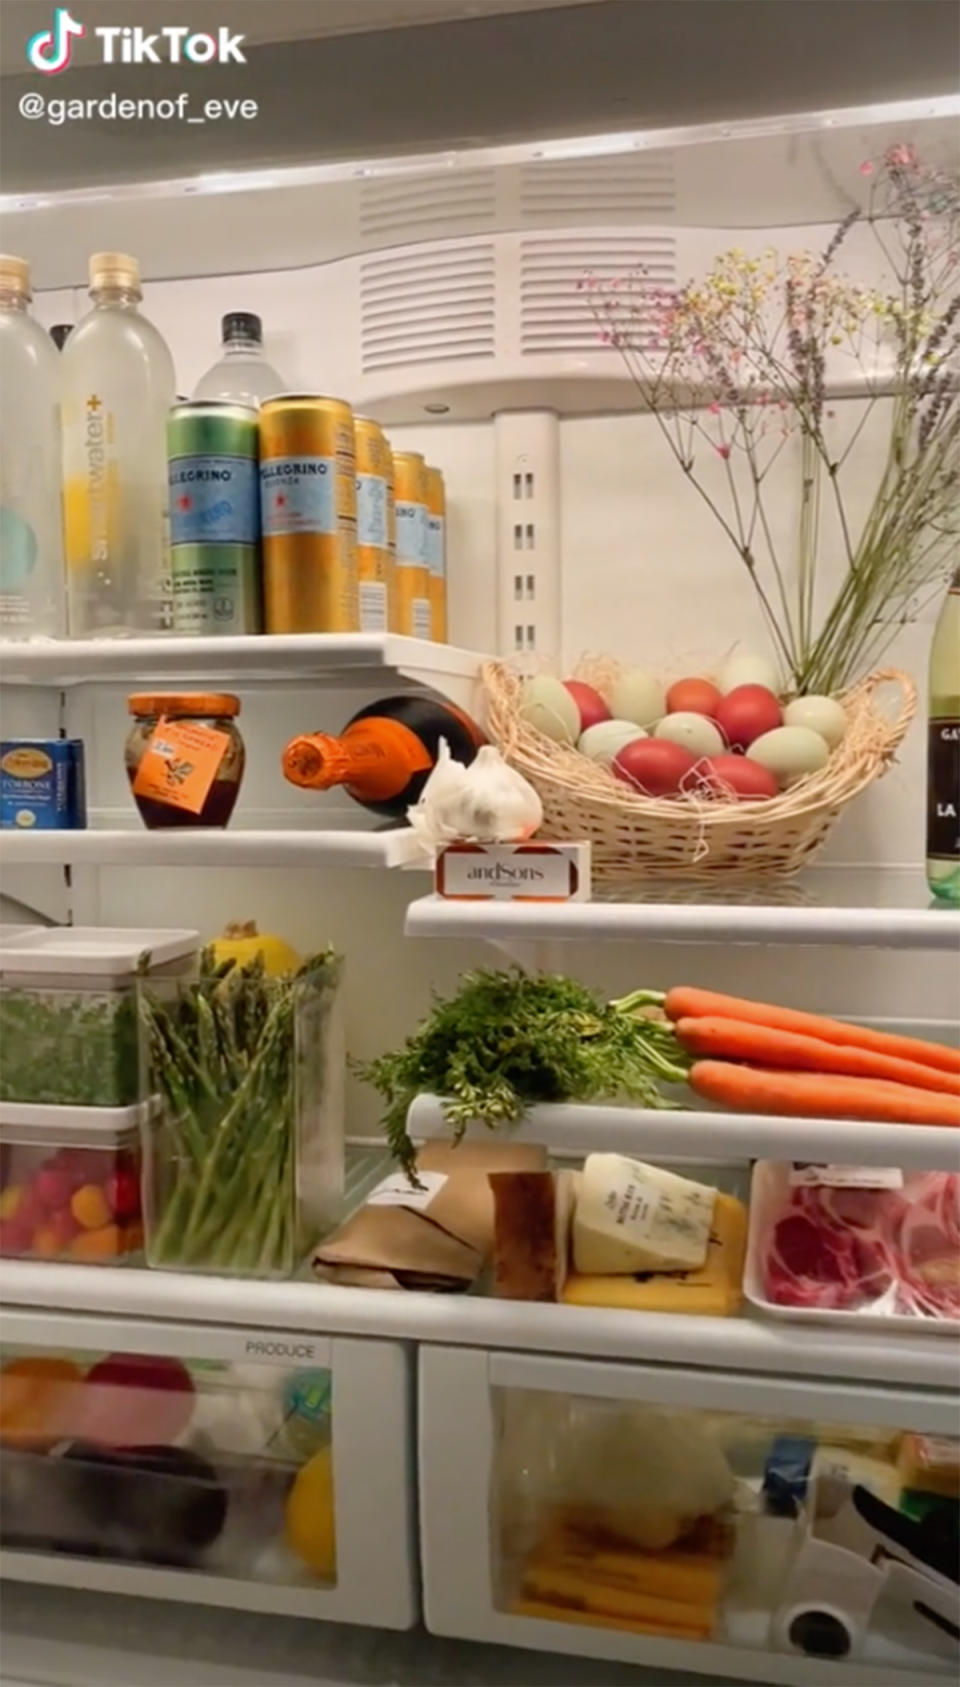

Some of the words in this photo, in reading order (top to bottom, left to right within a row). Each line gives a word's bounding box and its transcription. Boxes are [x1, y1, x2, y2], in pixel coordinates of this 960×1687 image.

[85, 394, 108, 561] smrtwater+
[936, 803, 957, 818] LA
[245, 1340, 316, 1359] PRODUCE
